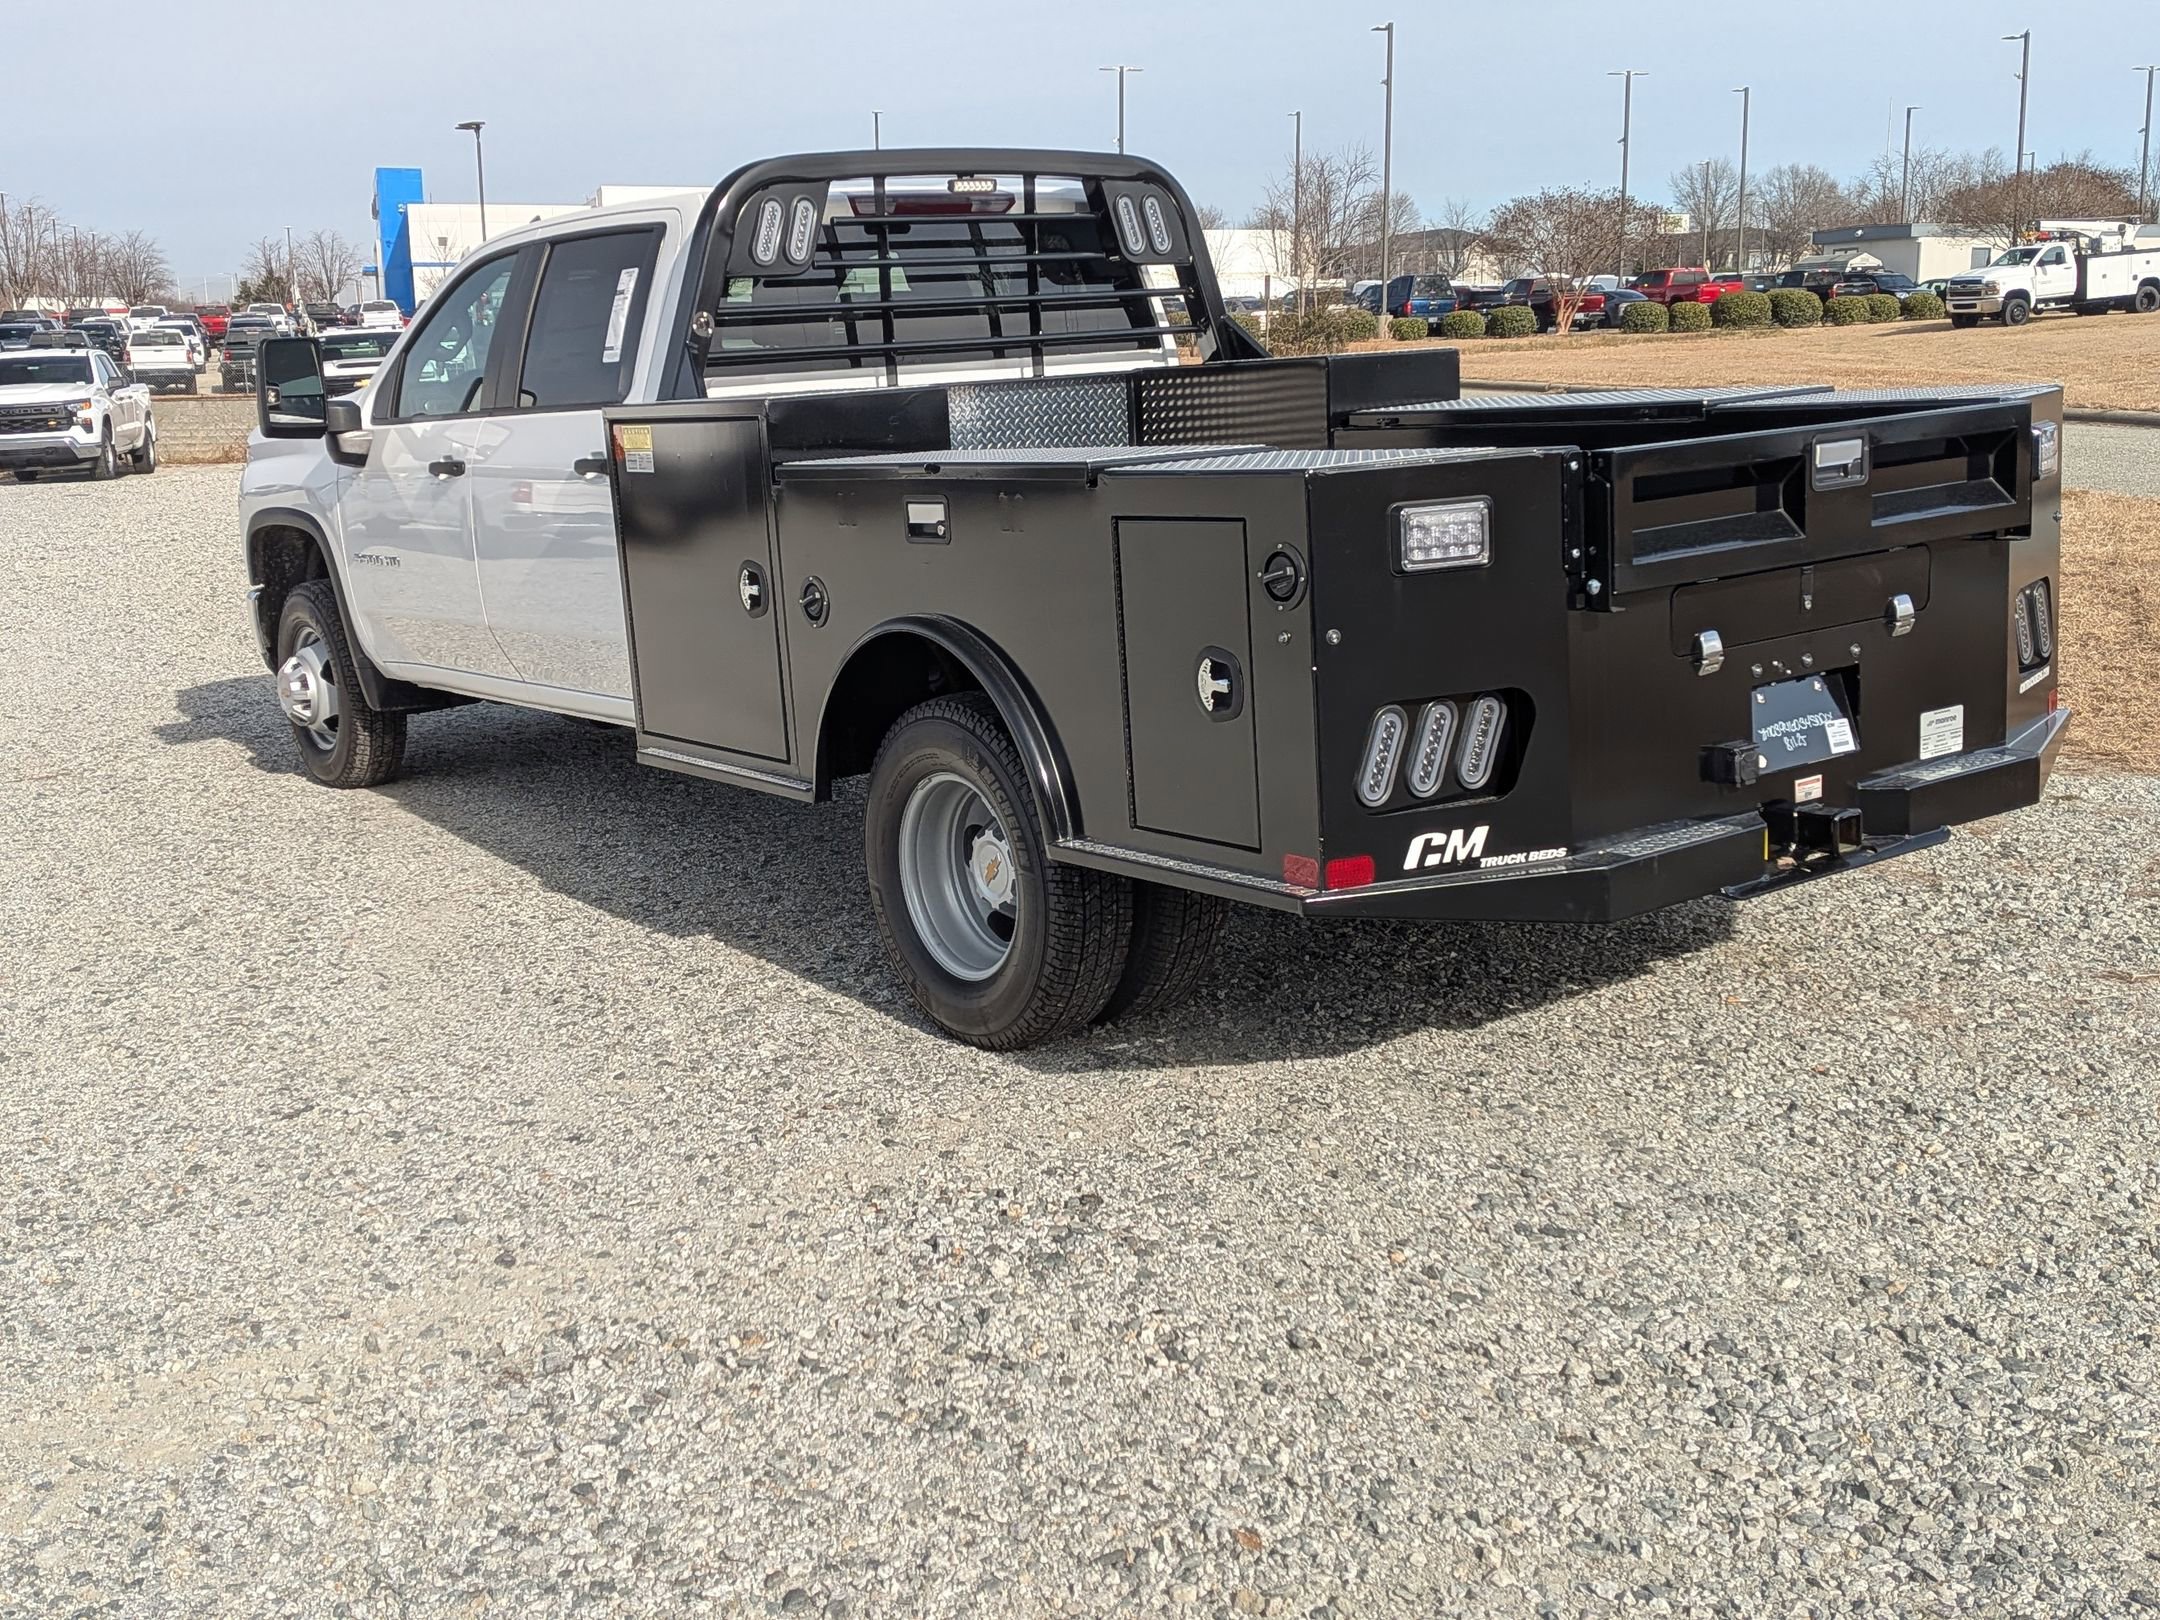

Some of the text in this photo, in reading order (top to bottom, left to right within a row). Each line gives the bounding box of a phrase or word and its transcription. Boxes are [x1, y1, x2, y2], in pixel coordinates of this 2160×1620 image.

[979, 765, 1031, 868] MICHELIN
[1403, 825, 1490, 871] CM
[1479, 847, 1568, 868] TRUCK BEDS
